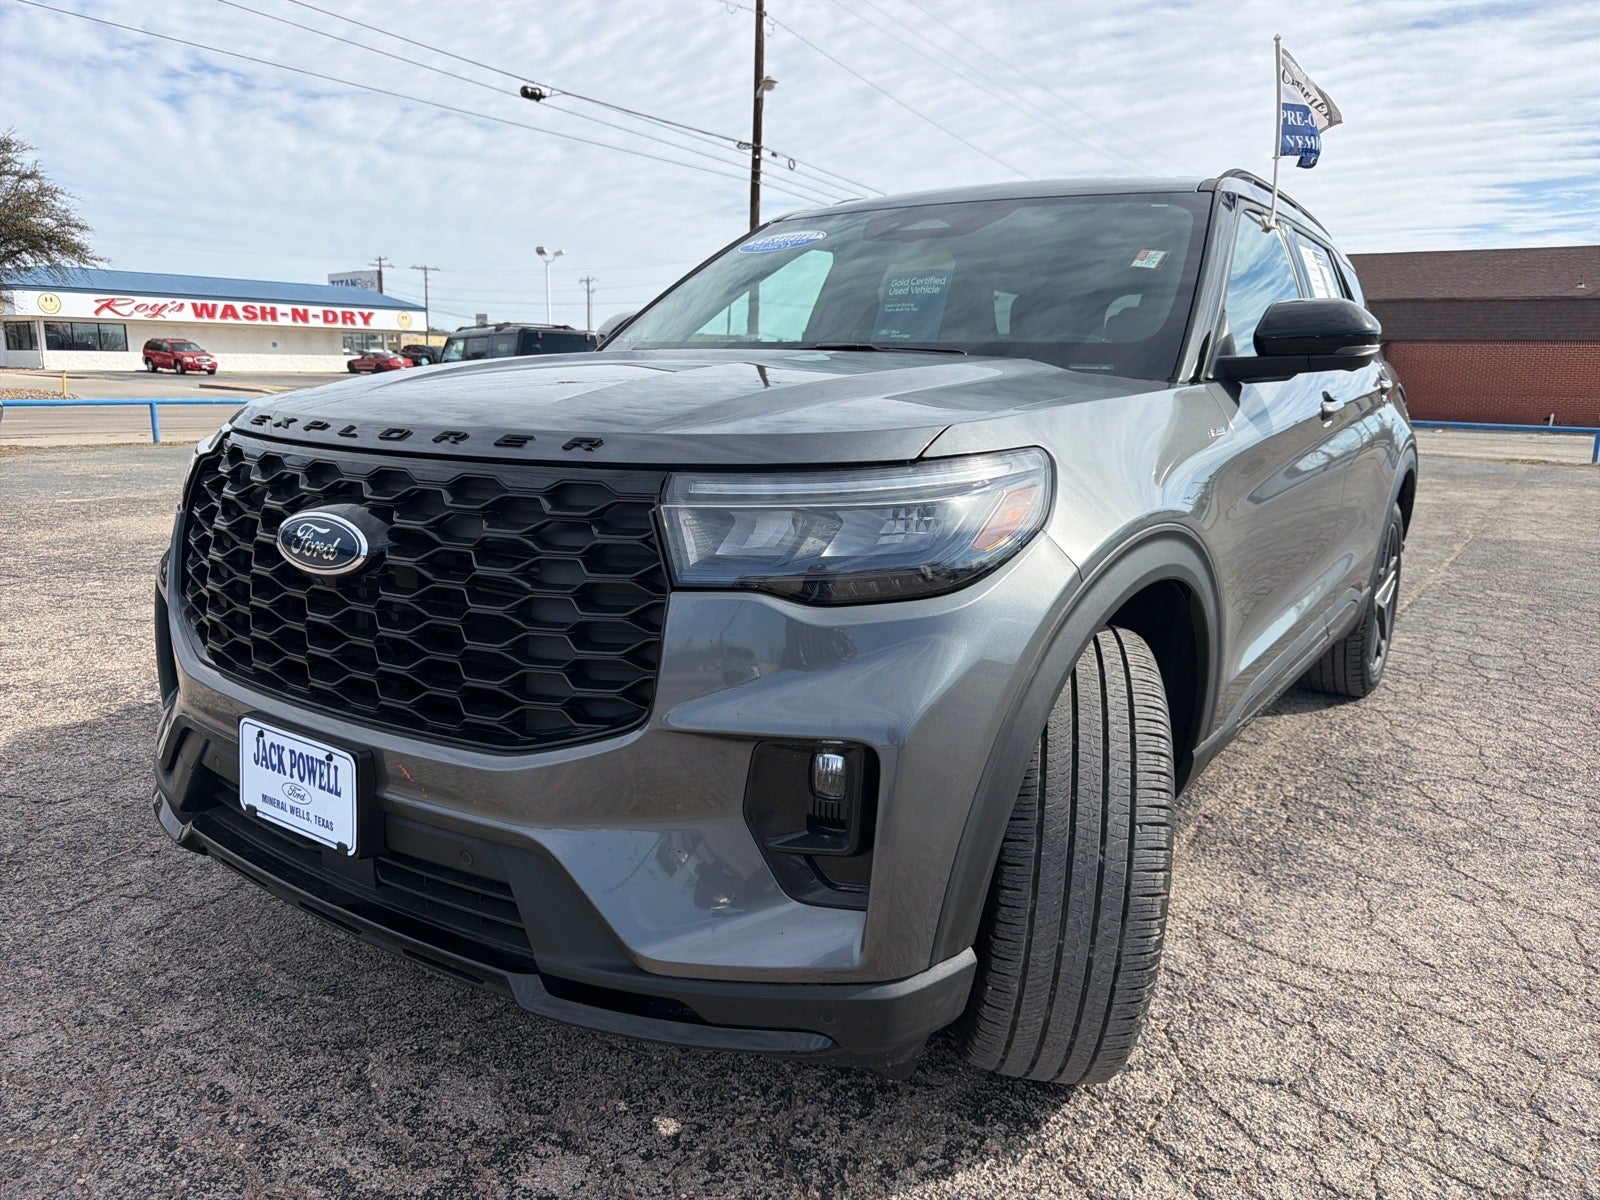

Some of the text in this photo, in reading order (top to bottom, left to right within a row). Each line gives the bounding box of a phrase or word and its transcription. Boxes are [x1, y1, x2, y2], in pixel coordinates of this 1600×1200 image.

[1285, 135, 1321, 151] VEHI
[889, 286, 940, 296] Used Vehicle
[891, 276, 947, 288] Gold Certified
[94, 298, 375, 327] Roy's WASH-N-DRY
[250, 414, 605, 452] EXPLORER
[290, 523, 339, 561] Ford
[253, 736, 342, 798] JACK POWELL
[287, 784, 307, 802] Ford
[261, 793, 334, 832] MINERAL WELLS, TEXAS
